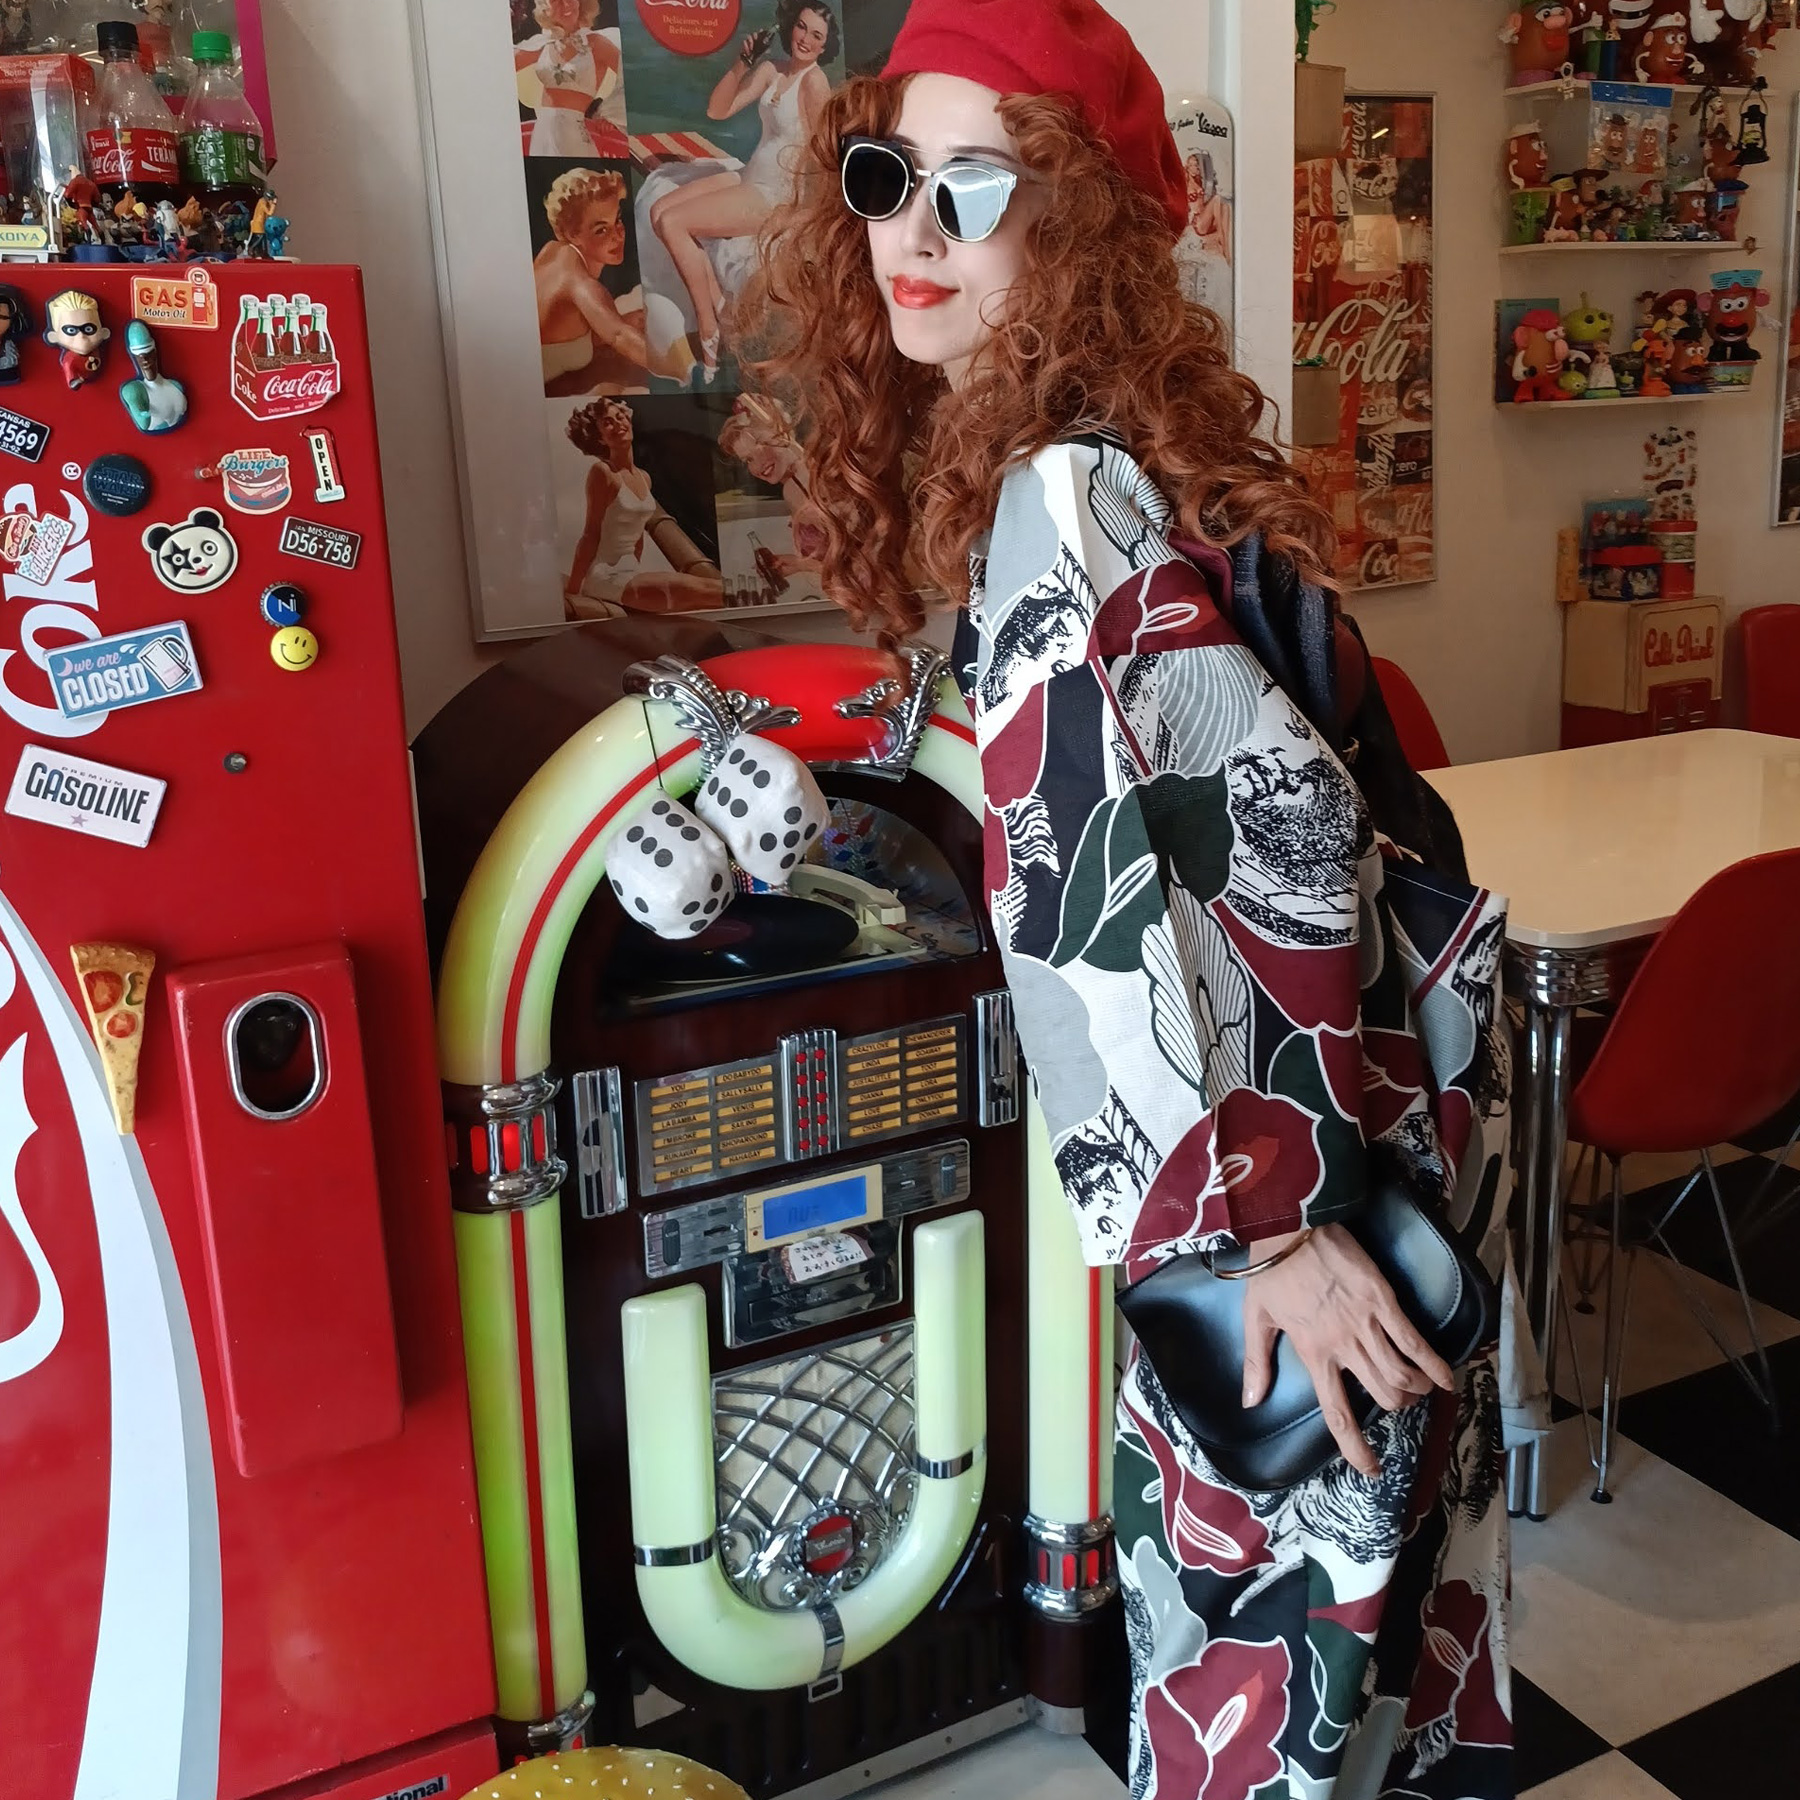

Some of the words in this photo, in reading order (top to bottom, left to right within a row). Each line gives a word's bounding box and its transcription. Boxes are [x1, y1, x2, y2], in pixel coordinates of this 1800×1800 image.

[139, 287, 188, 308] GAS
[144, 307, 170, 318] Motor
[172, 309, 186, 319] Oil
[263, 368, 335, 402] Coca-Cola
[224, 455, 288, 476] Burgers
[239, 450, 271, 461] LIFE
[315, 437, 333, 491] OPEN
[308, 526, 349, 543] MISSOURI
[286, 529, 352, 564] D56-758
[74, 657, 93, 673] we
[96, 651, 121, 668] are
[62, 662, 149, 711] CLOSED
[25, 761, 150, 825] GASOLINE
[671, 1083, 686, 1092] YOU
[670, 1100, 688, 1110] JODY
[732, 1103, 754, 1112] VENUS
[669, 1166, 694, 1177] HEART
